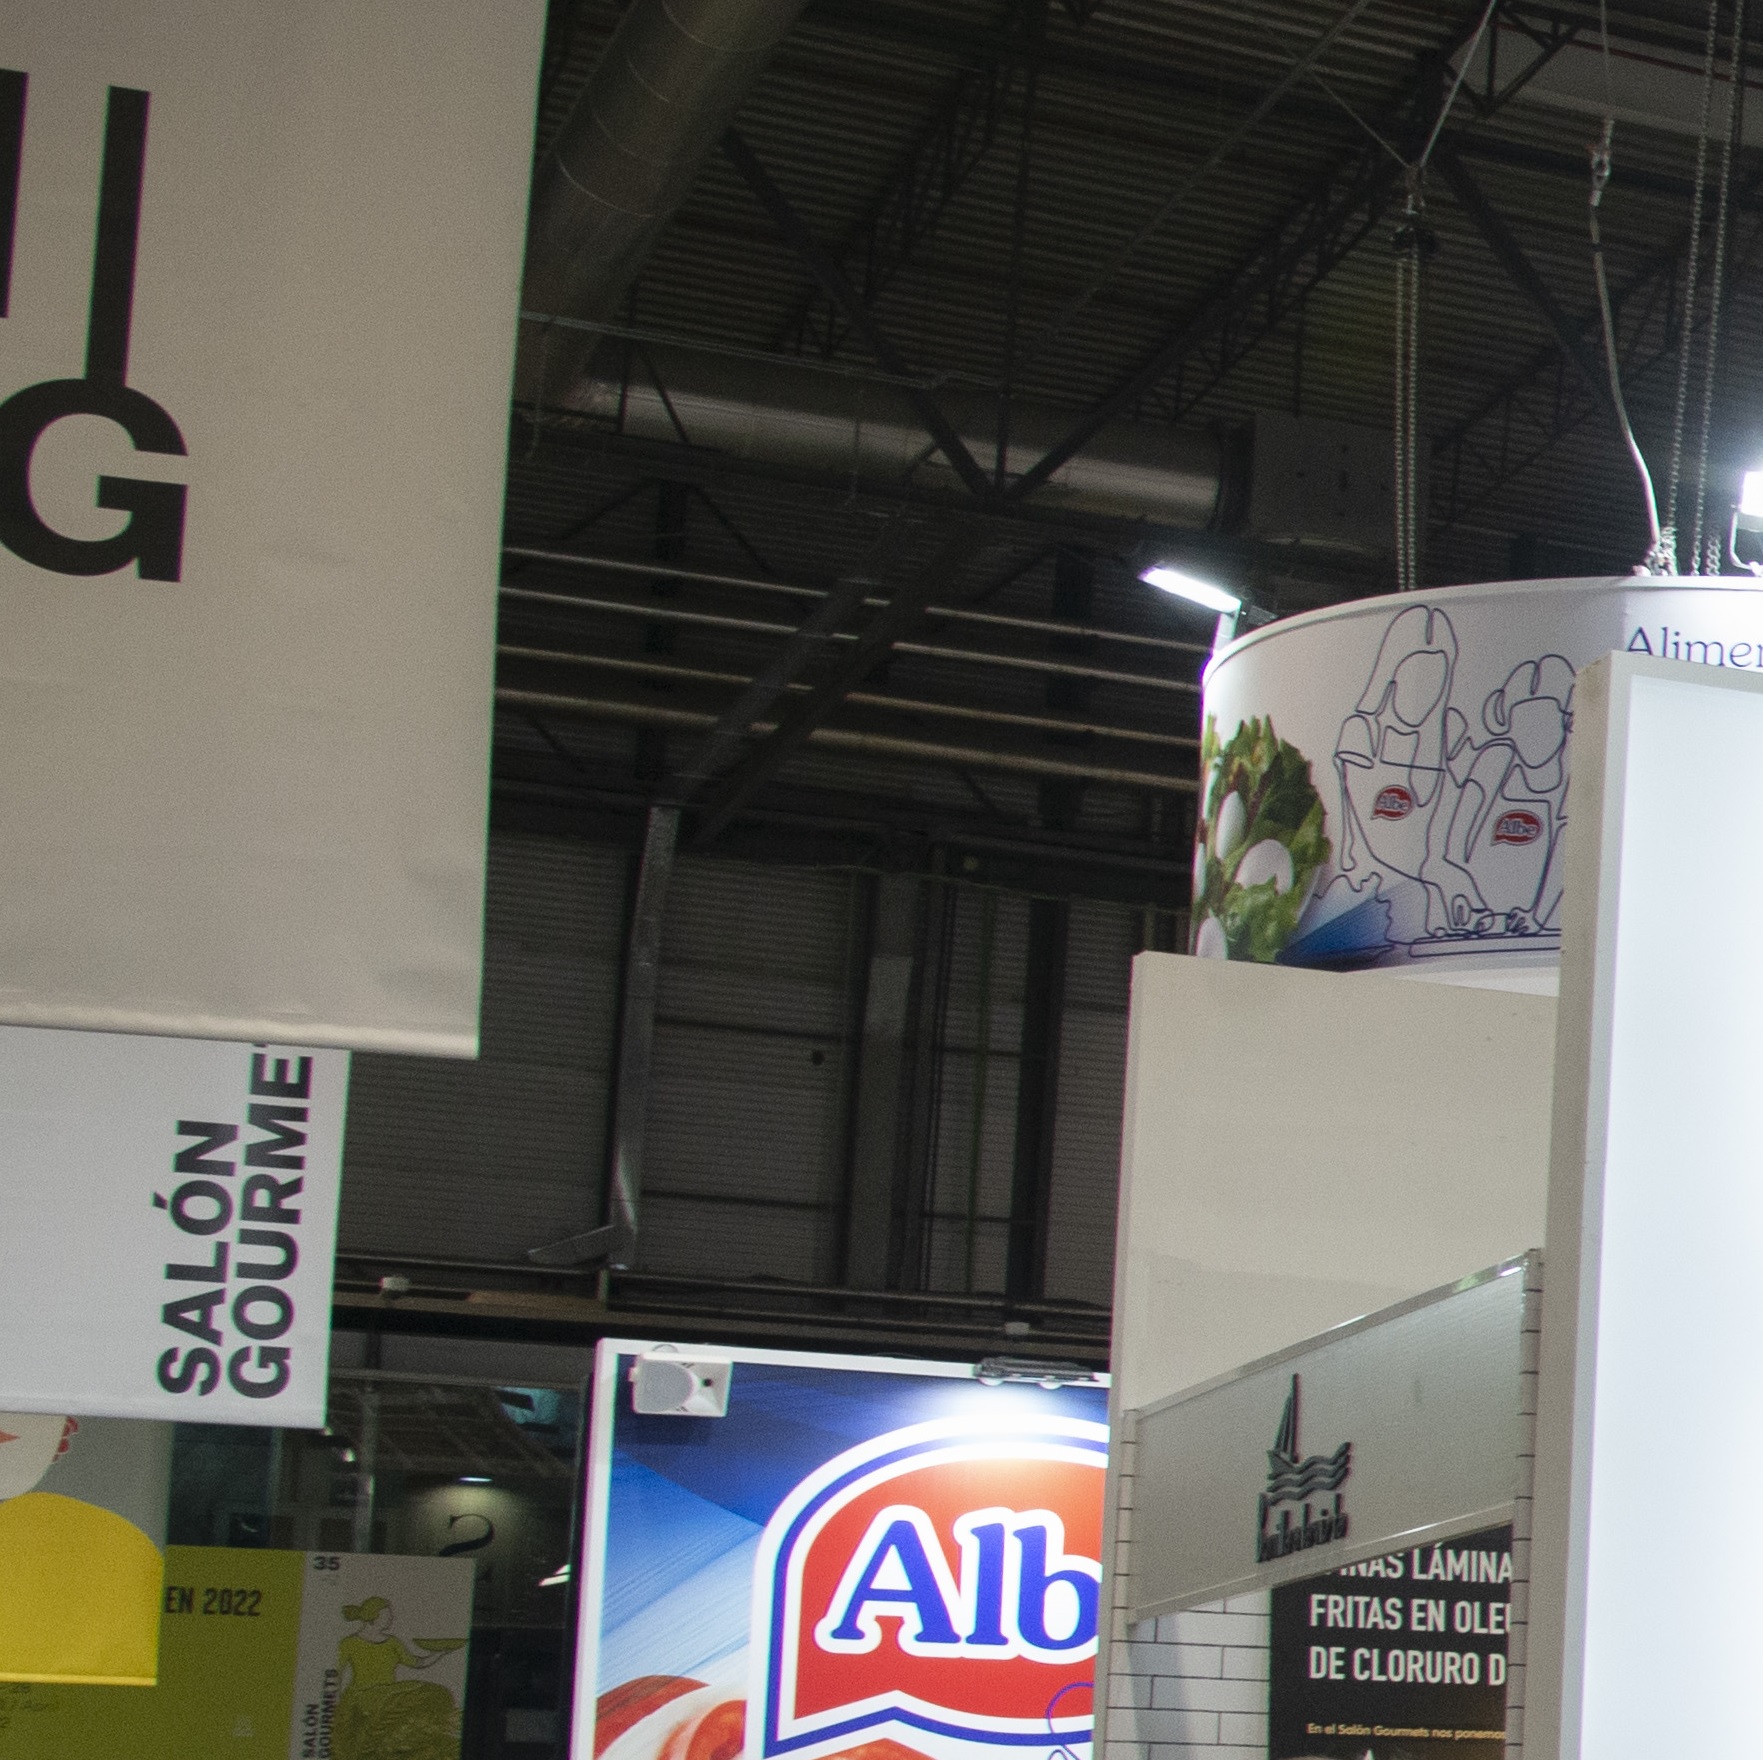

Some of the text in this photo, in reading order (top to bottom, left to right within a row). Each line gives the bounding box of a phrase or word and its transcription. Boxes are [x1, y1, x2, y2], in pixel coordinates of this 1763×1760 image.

[230, 1042, 315, 1399] GOURME
[155, 1119, 239, 1396] SALÓN
[313, 1556, 341, 1571] 35
[164, 1586, 263, 1617] EN 2022
[1309, 1593, 1512, 1635] FRITAS EN OLE
[1309, 1645, 1346, 1680] DE
[1353, 1647, 1481, 1685] CLORURO
[303, 1703, 318, 1759] SALÓN
[319, 1668, 339, 1759] GOURMETS
[1307, 1723, 1322, 1735] En
[1324, 1723, 1336, 1735] el
[1338, 1723, 1371, 1736] Salón
[1373, 1726, 1430, 1739] Gourmets
[1432, 1729, 1453, 1739] nos
